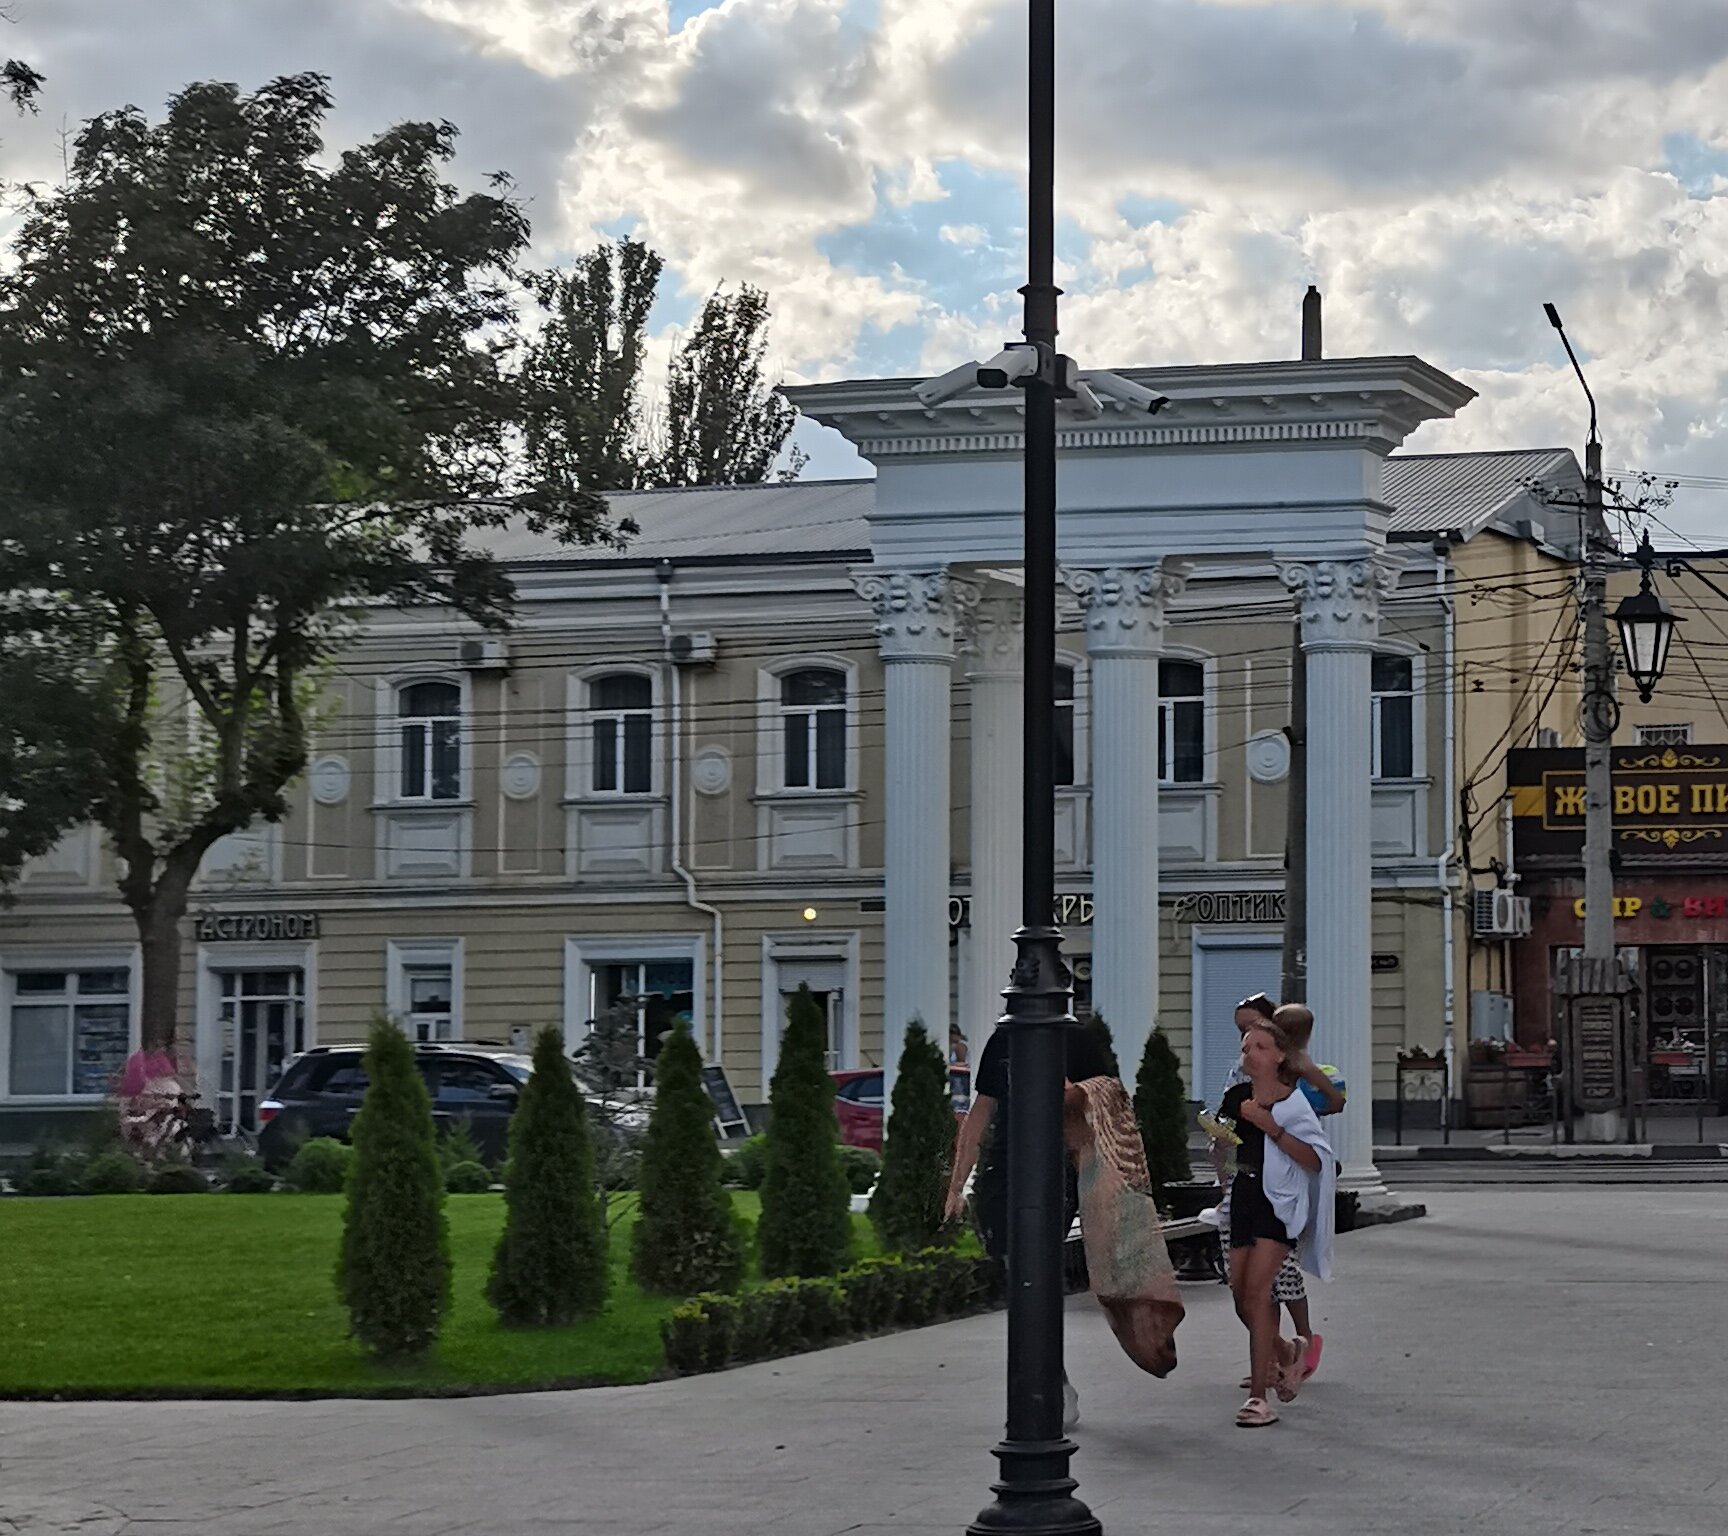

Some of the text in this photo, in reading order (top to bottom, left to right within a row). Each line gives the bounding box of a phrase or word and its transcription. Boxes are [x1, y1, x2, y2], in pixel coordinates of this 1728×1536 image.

[1554, 783, 1681, 815] ЖВОЕ
[1198, 892, 1286, 921] ОПТИК
[1573, 896, 1643, 918] СР
